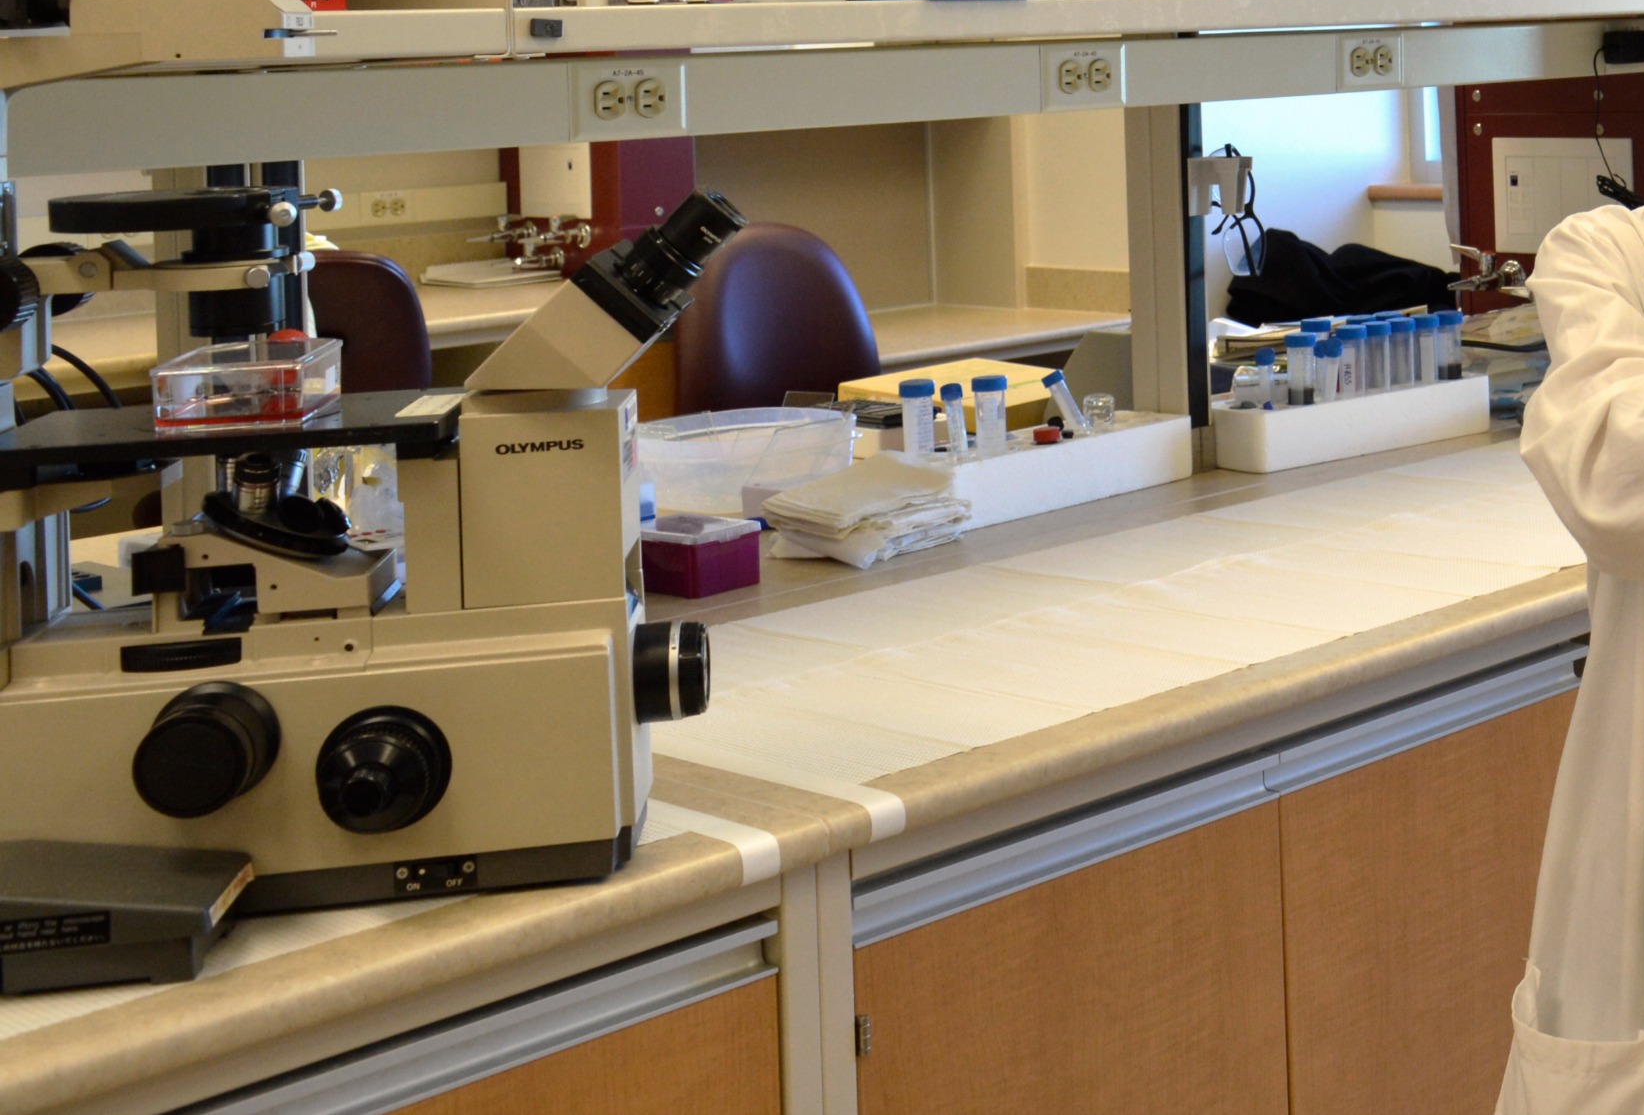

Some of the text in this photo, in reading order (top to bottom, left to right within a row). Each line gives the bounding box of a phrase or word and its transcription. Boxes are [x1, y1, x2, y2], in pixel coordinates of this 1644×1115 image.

[495, 438, 585, 455] OLYMPUS
[406, 878, 463, 891] ON OFF
